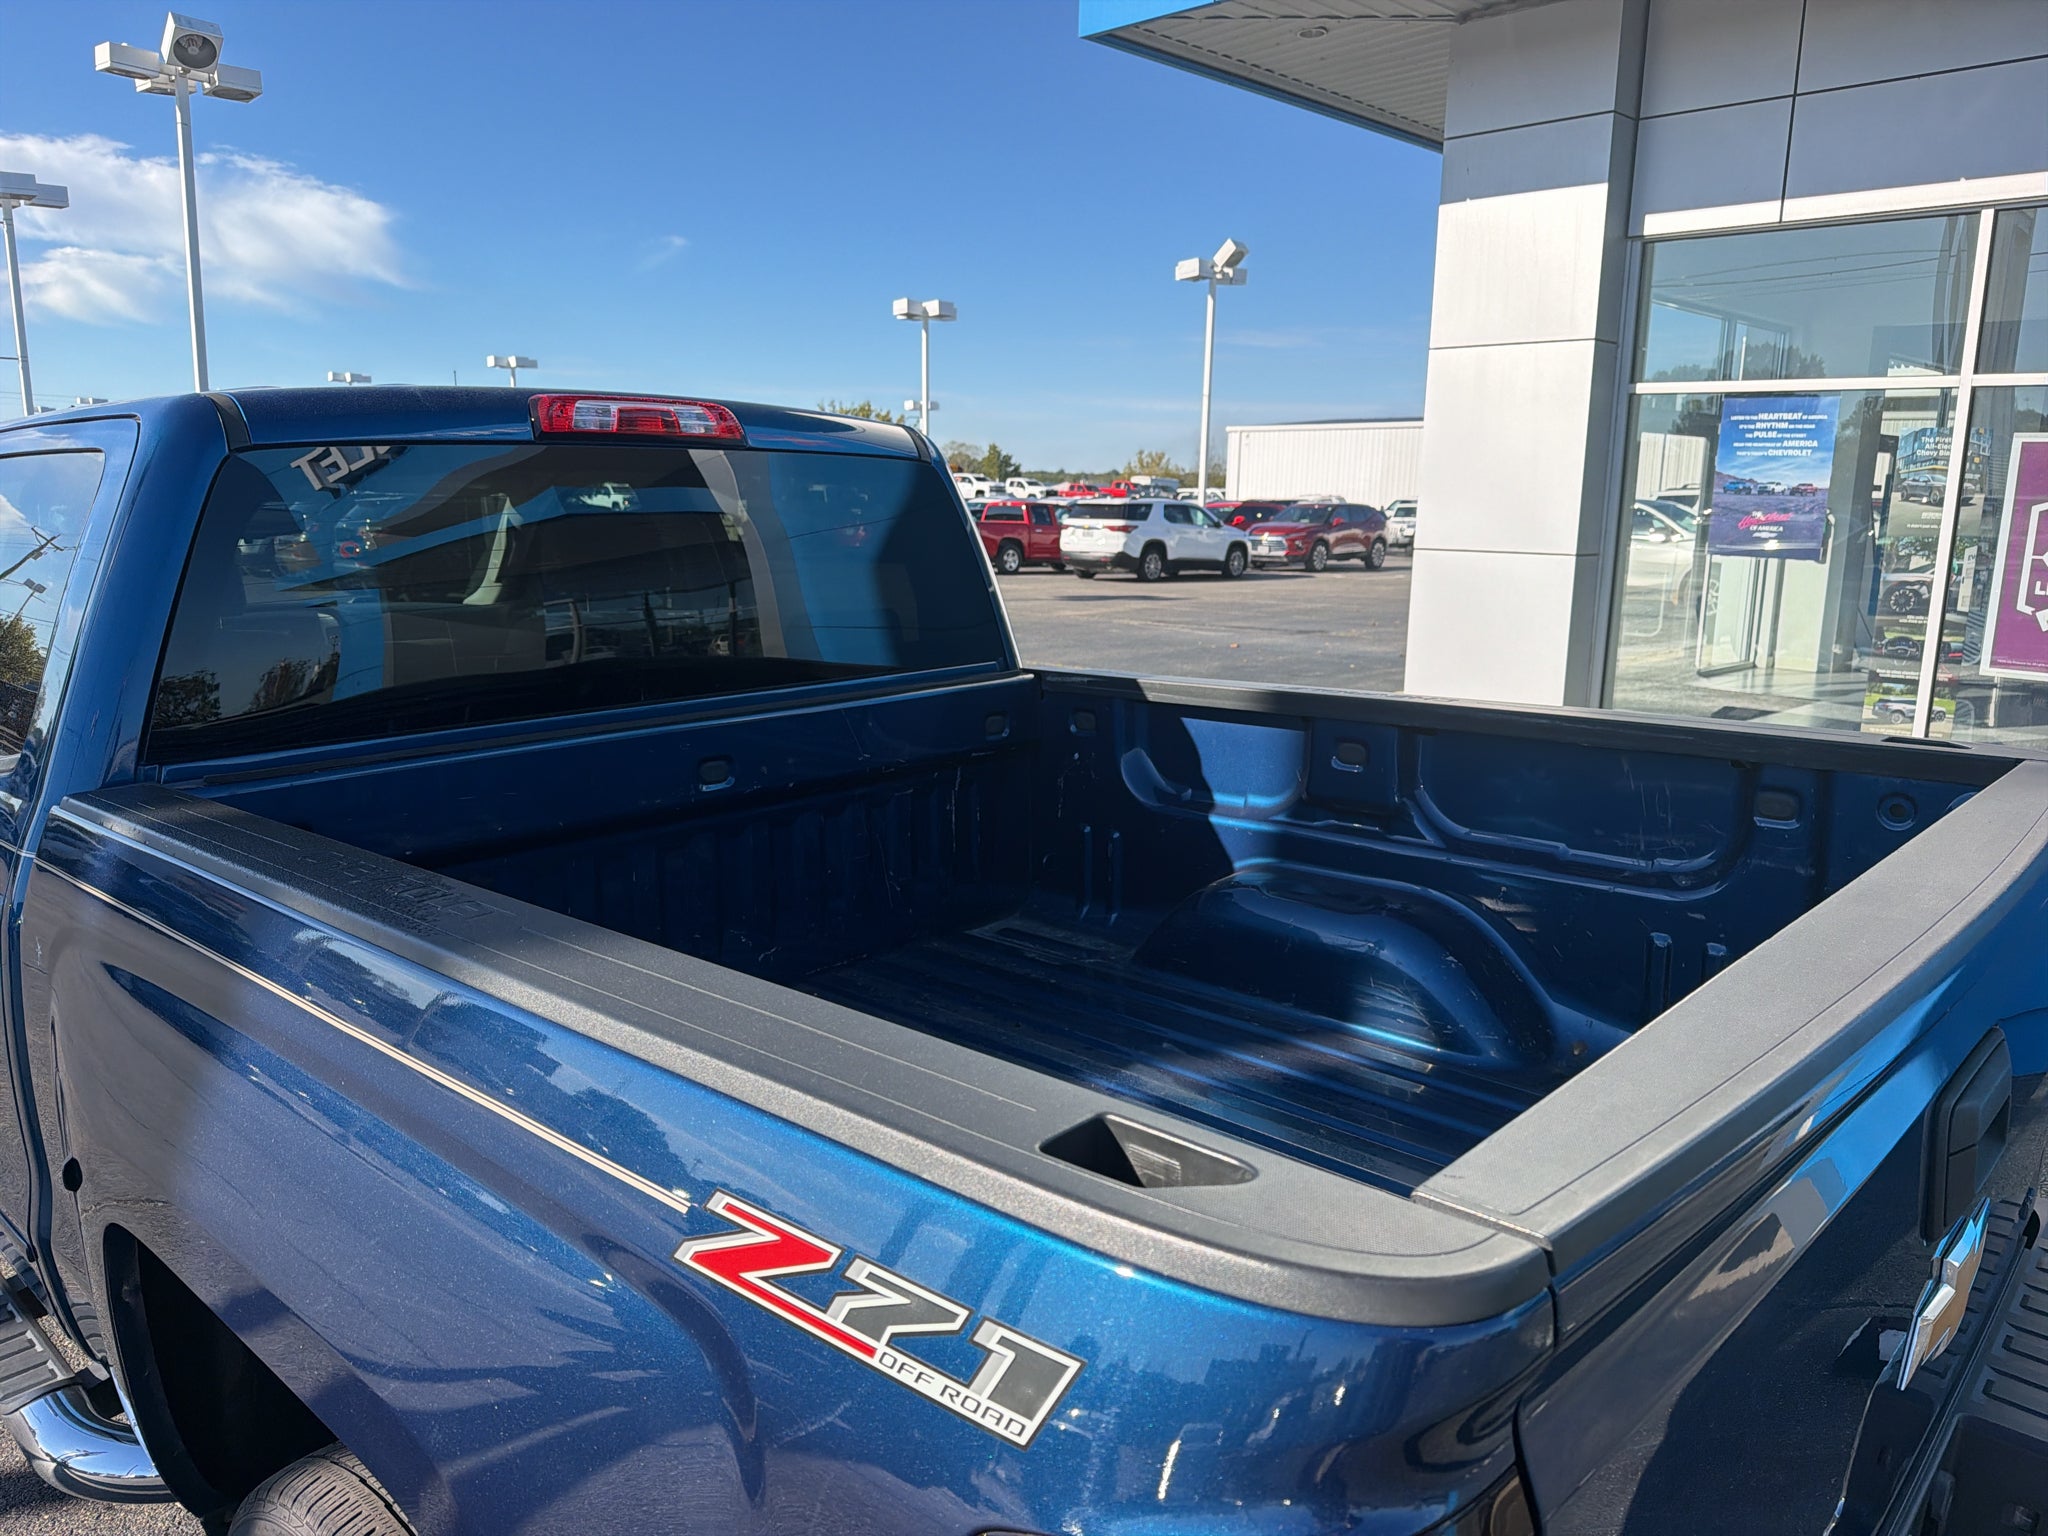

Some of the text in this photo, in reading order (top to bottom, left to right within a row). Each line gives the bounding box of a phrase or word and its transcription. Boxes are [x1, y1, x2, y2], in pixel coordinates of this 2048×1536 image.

[1758, 412, 1803, 420] HEARTBEAT
[1916, 449, 1938, 457] Chevy
[673, 1189, 1086, 1424] Z71
[878, 1352, 1028, 1438] OFF ROAD
